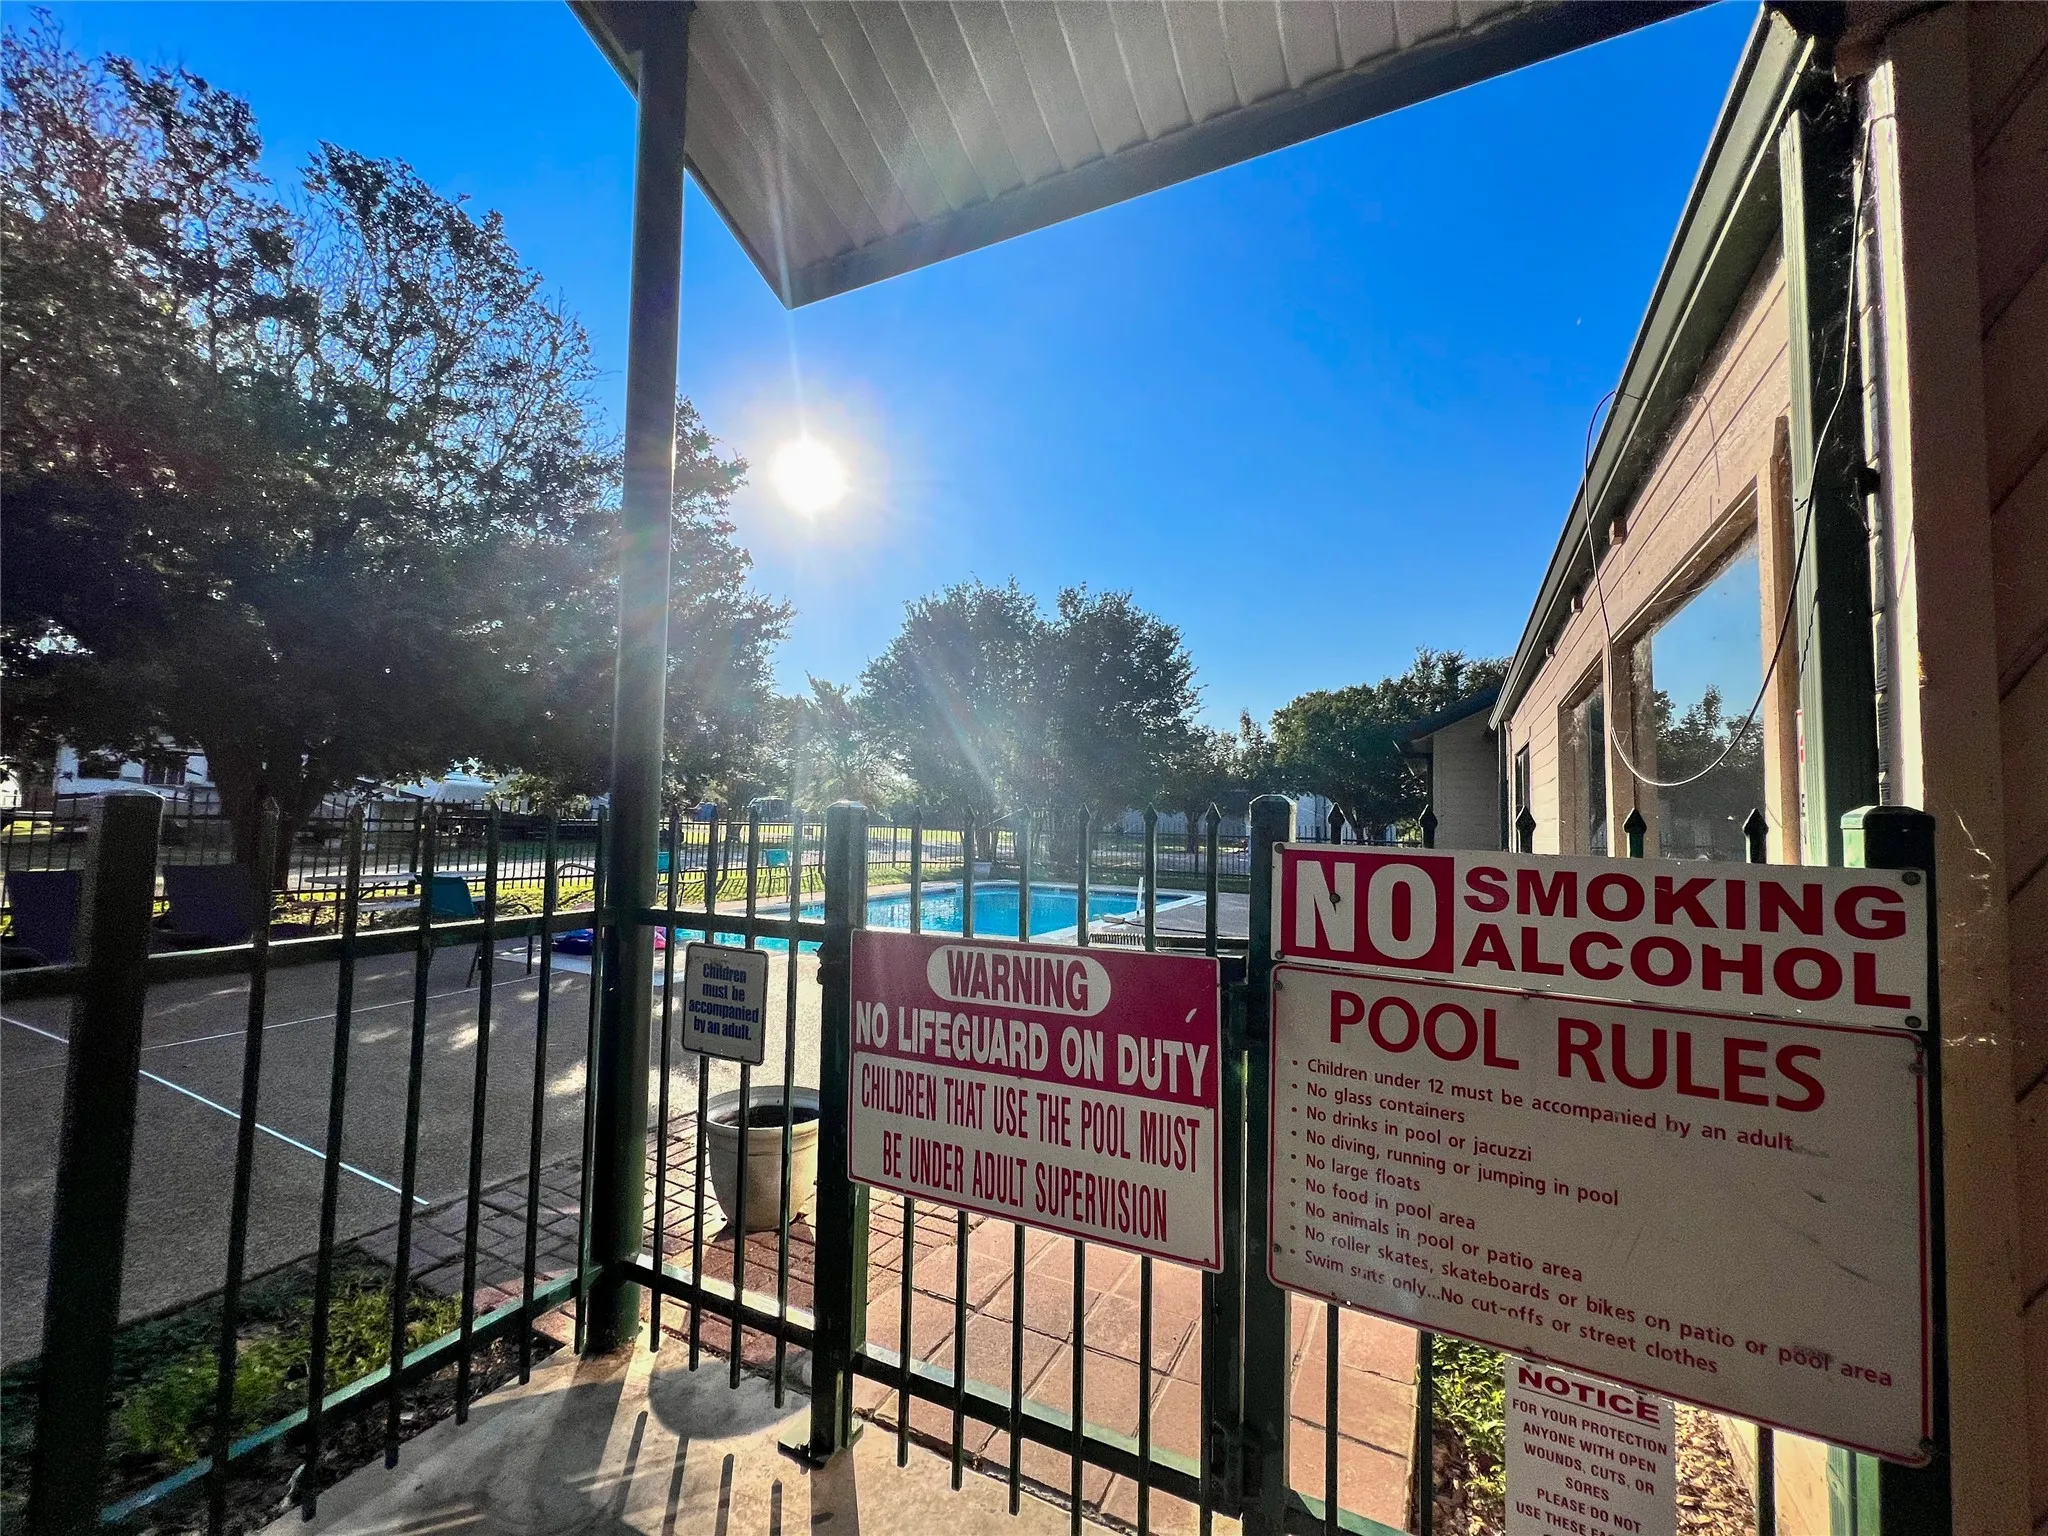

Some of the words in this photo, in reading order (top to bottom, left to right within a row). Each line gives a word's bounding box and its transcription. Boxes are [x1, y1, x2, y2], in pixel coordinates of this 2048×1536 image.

[1295, 860, 1437, 961] NO
[1463, 866, 1907, 941] SMOKING
[702, 962, 746, 984] Children
[702, 983, 728, 999] must
[731, 986, 745, 1002] be
[947, 950, 1089, 1011] WARNING
[1461, 923, 1911, 1010] ALCOHOL
[688, 1000, 759, 1023] accompanied
[693, 1016, 706, 1033] by
[707, 1021, 720, 1035] an
[722, 1023, 752, 1041] adult.
[855, 1001, 889, 1049] NO
[898, 1007, 1049, 1073] LIFEGUARD
[1060, 1026, 1104, 1082] ON
[1117, 1034, 1210, 1097] DUTY
[1330, 990, 1520, 1071] POOL
[1557, 1017, 1826, 1113] RULES
[861, 1063, 937, 1121] CHILDREN
[943, 1077, 987, 1131] THAT
[994, 1085, 1028, 1138] USE
[1036, 1092, 1072, 1148] THE
[1081, 1100, 1131, 1160] POOL
[1140, 1110, 1200, 1173] MUST
[1306, 1082, 1327, 1098] No
[1334, 1087, 1372, 1106] glass
[1379, 1097, 1465, 1123] containers
[1307, 1058, 1368, 1082] Children
[1374, 1073, 1420, 1090] under
[1428, 1078, 1444, 1094] 12
[1451, 1084, 1494, 1103] must
[1501, 1089, 1523, 1107] be
[1531, 1098, 1657, 1129] accompanied
[1666, 1114, 1691, 1138] by
[1701, 1123, 1726, 1140] an
[1737, 1129, 1794, 1151] adult
[1306, 1106, 1326, 1122] No
[1332, 1110, 1378, 1132] drinks
[1384, 1120, 1398, 1137] in
[1405, 1128, 1441, 1145] pool
[1448, 1135, 1466, 1149] or
[1473, 1136, 1532, 1162] jacuzzi
[883, 1130, 902, 1178] BE
[909, 1136, 964, 1194] UNDER
[972, 1150, 1028, 1208] ADULT
[1035, 1161, 1168, 1242] SUPERVISION
[1306, 1129, 1326, 1145] No
[1331, 1133, 1380, 1159] diving,
[1387, 1148, 1446, 1175] running
[1453, 1162, 1470, 1176] or
[1477, 1163, 1546, 1195] jumping
[1553, 1178, 1569, 1197] in
[1577, 1187, 1619, 1206] pool
[1306, 1153, 1325, 1170] No
[1331, 1157, 1369, 1182] large
[1375, 1168, 1421, 1192] floats
[1305, 1177, 1325, 1195] No
[1332, 1184, 1368, 1205] food
[1374, 1192, 1389, 1209] in
[1395, 1199, 1431, 1220] pool
[1439, 1211, 1476, 1231] area
[1305, 1201, 1325, 1218] No
[1332, 1210, 1390, 1235] animals
[1396, 1223, 1410, 1241] in
[1417, 1231, 1454, 1252] pool
[1461, 1241, 1480, 1258] or
[1487, 1248, 1534, 1270] patio
[1542, 1262, 1583, 1282] area
[1305, 1225, 1325, 1243] No
[1331, 1233, 1371, 1255] roller
[1377, 1245, 1434, 1274] skates,
[1441, 1261, 1550, 1301] skateboards
[1558, 1293, 1578, 1308] or
[1586, 1295, 1636, 1323] bikes
[1644, 1314, 1671, 1332] on
[1679, 1322, 1735, 1348] patio
[1745, 1339, 1768, 1356] or
[1778, 1345, 1832, 1371] pool
[1840, 1360, 1893, 1387] area
[1305, 1250, 1344, 1274] Swim
[1471, 1297, 1544, 1327] cut-offs
[1552, 1319, 1571, 1334] or
[1579, 1324, 1636, 1352] street
[1645, 1341, 1718, 1374] clothes
[1518, 1366, 1660, 1424] NOTICE
[1512, 1398, 1538, 1415] FOR
[1541, 1406, 1578, 1429] YOUR
[1581, 1419, 1668, 1456] PROTECTION
[1523, 1422, 1576, 1449] ANYONE
[1579, 1439, 1614, 1461] WITH
[1619, 1452, 1657, 1475] OPEN
[1523, 1442, 1586, 1474] WOUNDS,
[1590, 1464, 1630, 1488] CUTS,
[1635, 1479, 1655, 1496] OR
[1565, 1476, 1610, 1502] SORES
[1516, 1501, 1541, 1520] USE
[1545, 1510, 1587, 1536] THESE
[1537, 1487, 1586, 1515] PLEASE
[1590, 1504, 1609, 1523] DO
[1613, 1513, 1642, 1534] NOT
